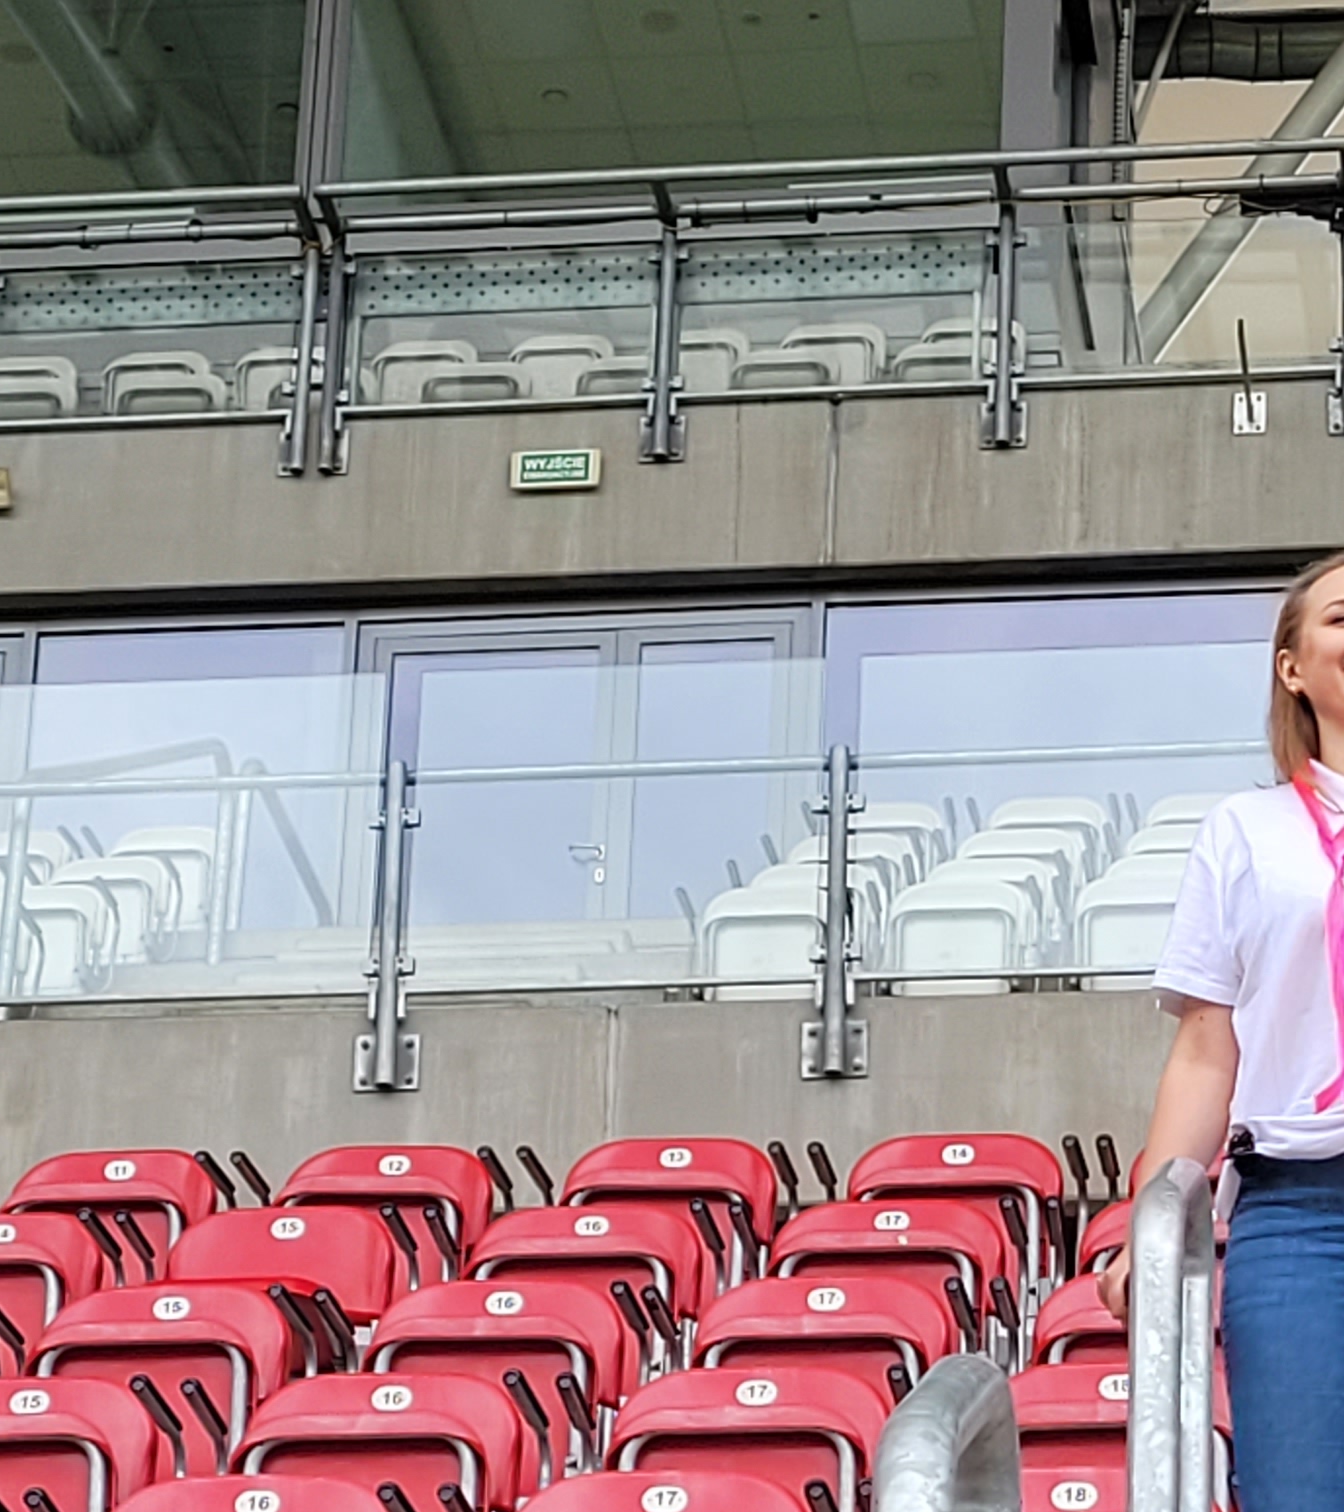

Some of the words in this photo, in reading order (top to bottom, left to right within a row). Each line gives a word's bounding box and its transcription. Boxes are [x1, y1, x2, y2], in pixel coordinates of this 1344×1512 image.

[951, 1148, 967, 1159] 14
[113, 1165, 127, 1177] 11
[388, 1160, 404, 1172] 12
[281, 1221, 299, 1233] 15
[584, 1221, 602, 1232] 16
[885, 1215, 902, 1226] 17
[496, 1296, 516, 1309] 16
[818, 1291, 837, 1305] 17
[163, 1301, 183, 1313] 15
[383, 1391, 404, 1405] 16
[747, 1384, 768, 1399] 17
[21, 1395, 41, 1409] 15
[655, 1490, 679, 1506] 17
[1065, 1487, 1087, 1503] 18
[248, 1495, 270, 1511] 16
